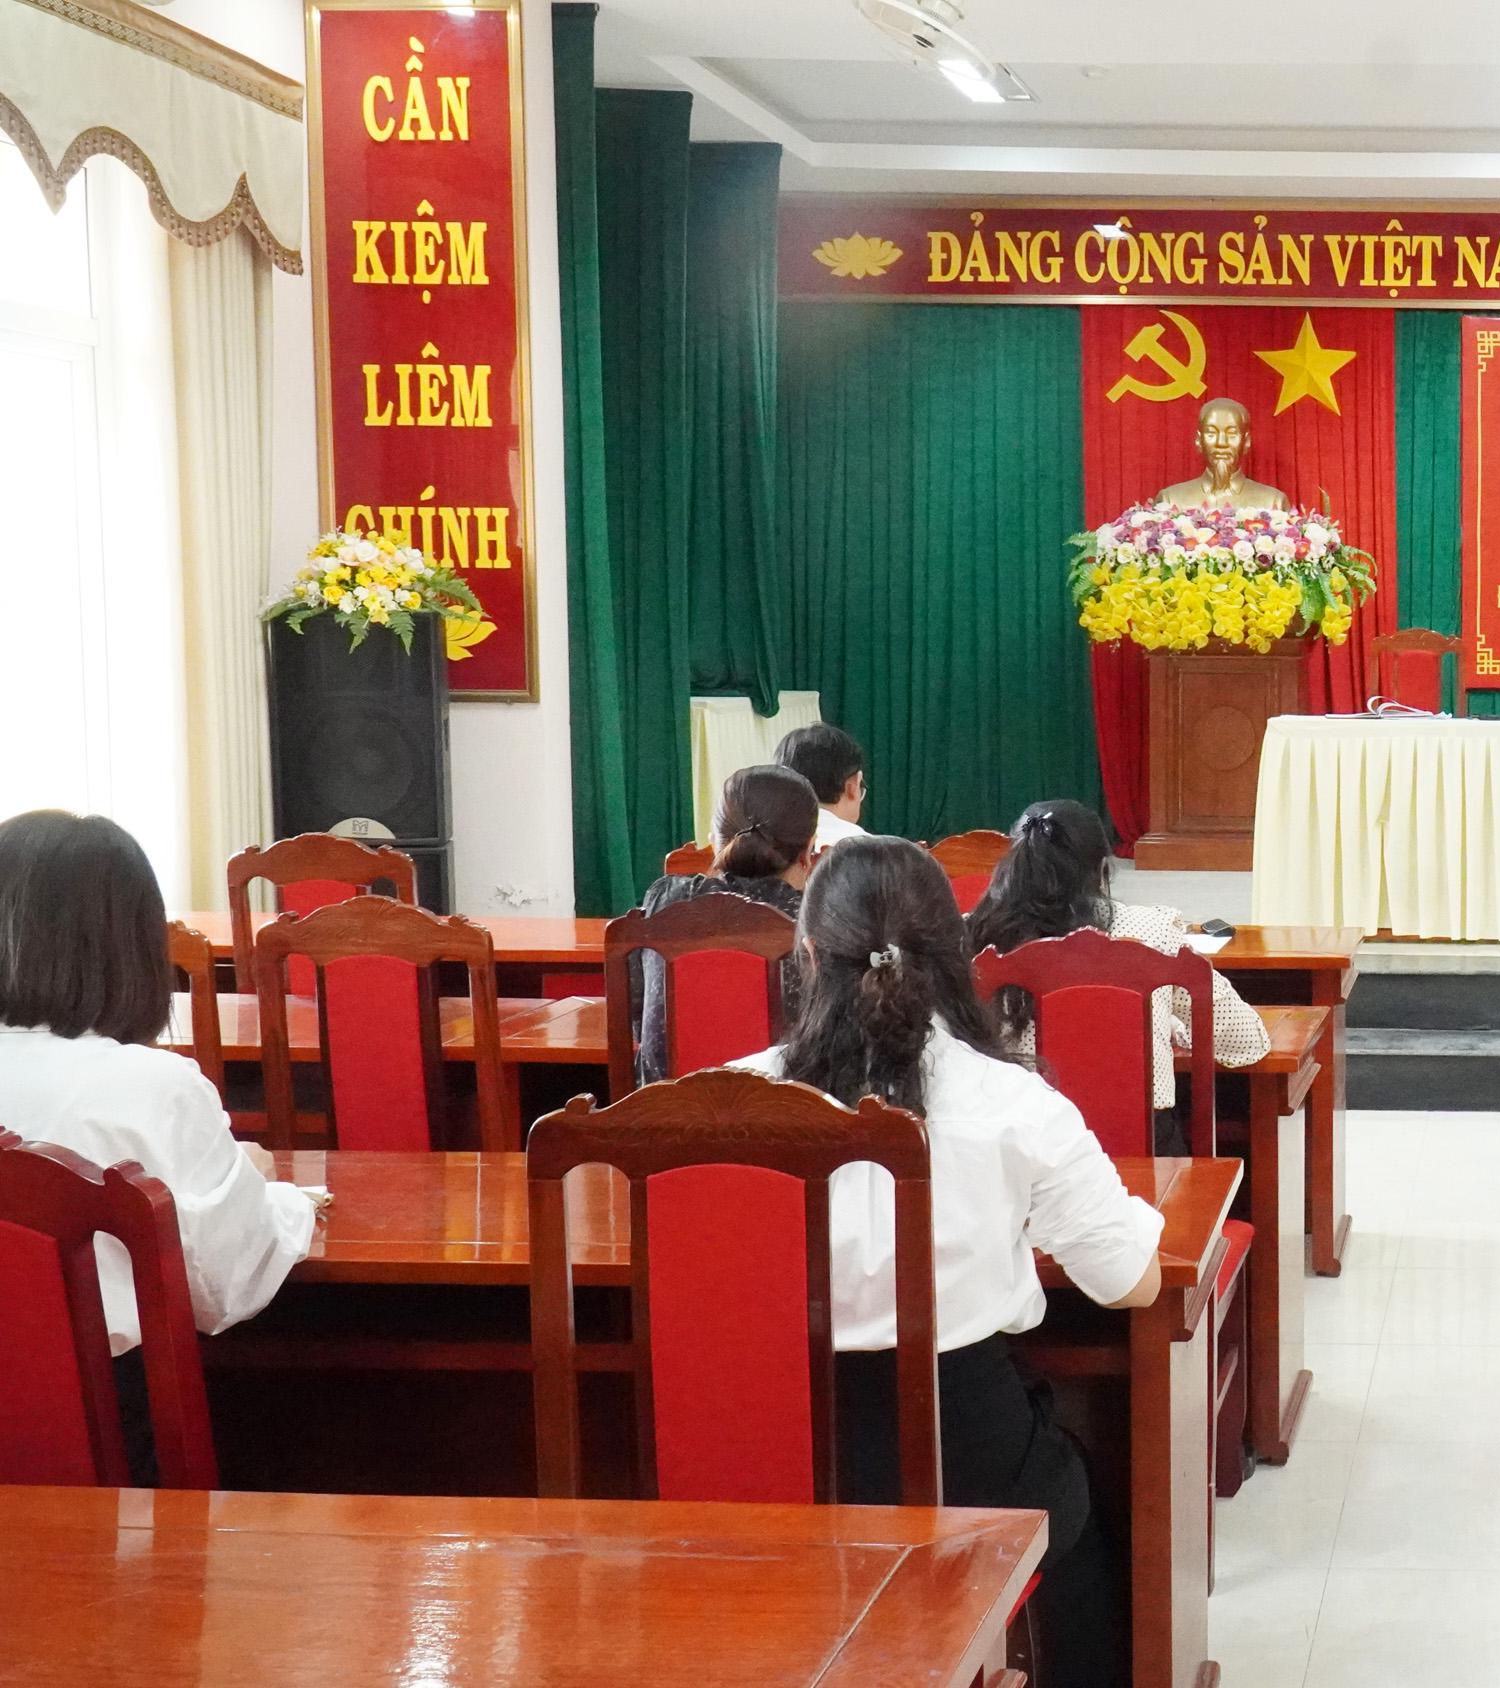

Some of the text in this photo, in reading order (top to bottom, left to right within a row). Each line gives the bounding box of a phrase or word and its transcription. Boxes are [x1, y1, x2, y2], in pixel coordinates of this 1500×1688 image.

[361, 36, 471, 142] CẦN
[351, 199, 490, 304] KIỆM
[927, 211, 1064, 284] ĐẢNG
[1074, 216, 1208, 295] CỘNG
[1218, 215, 1314, 286] SẢN
[1323, 219, 1443, 298] VIỆT
[362, 341, 493, 428] LIÊM
